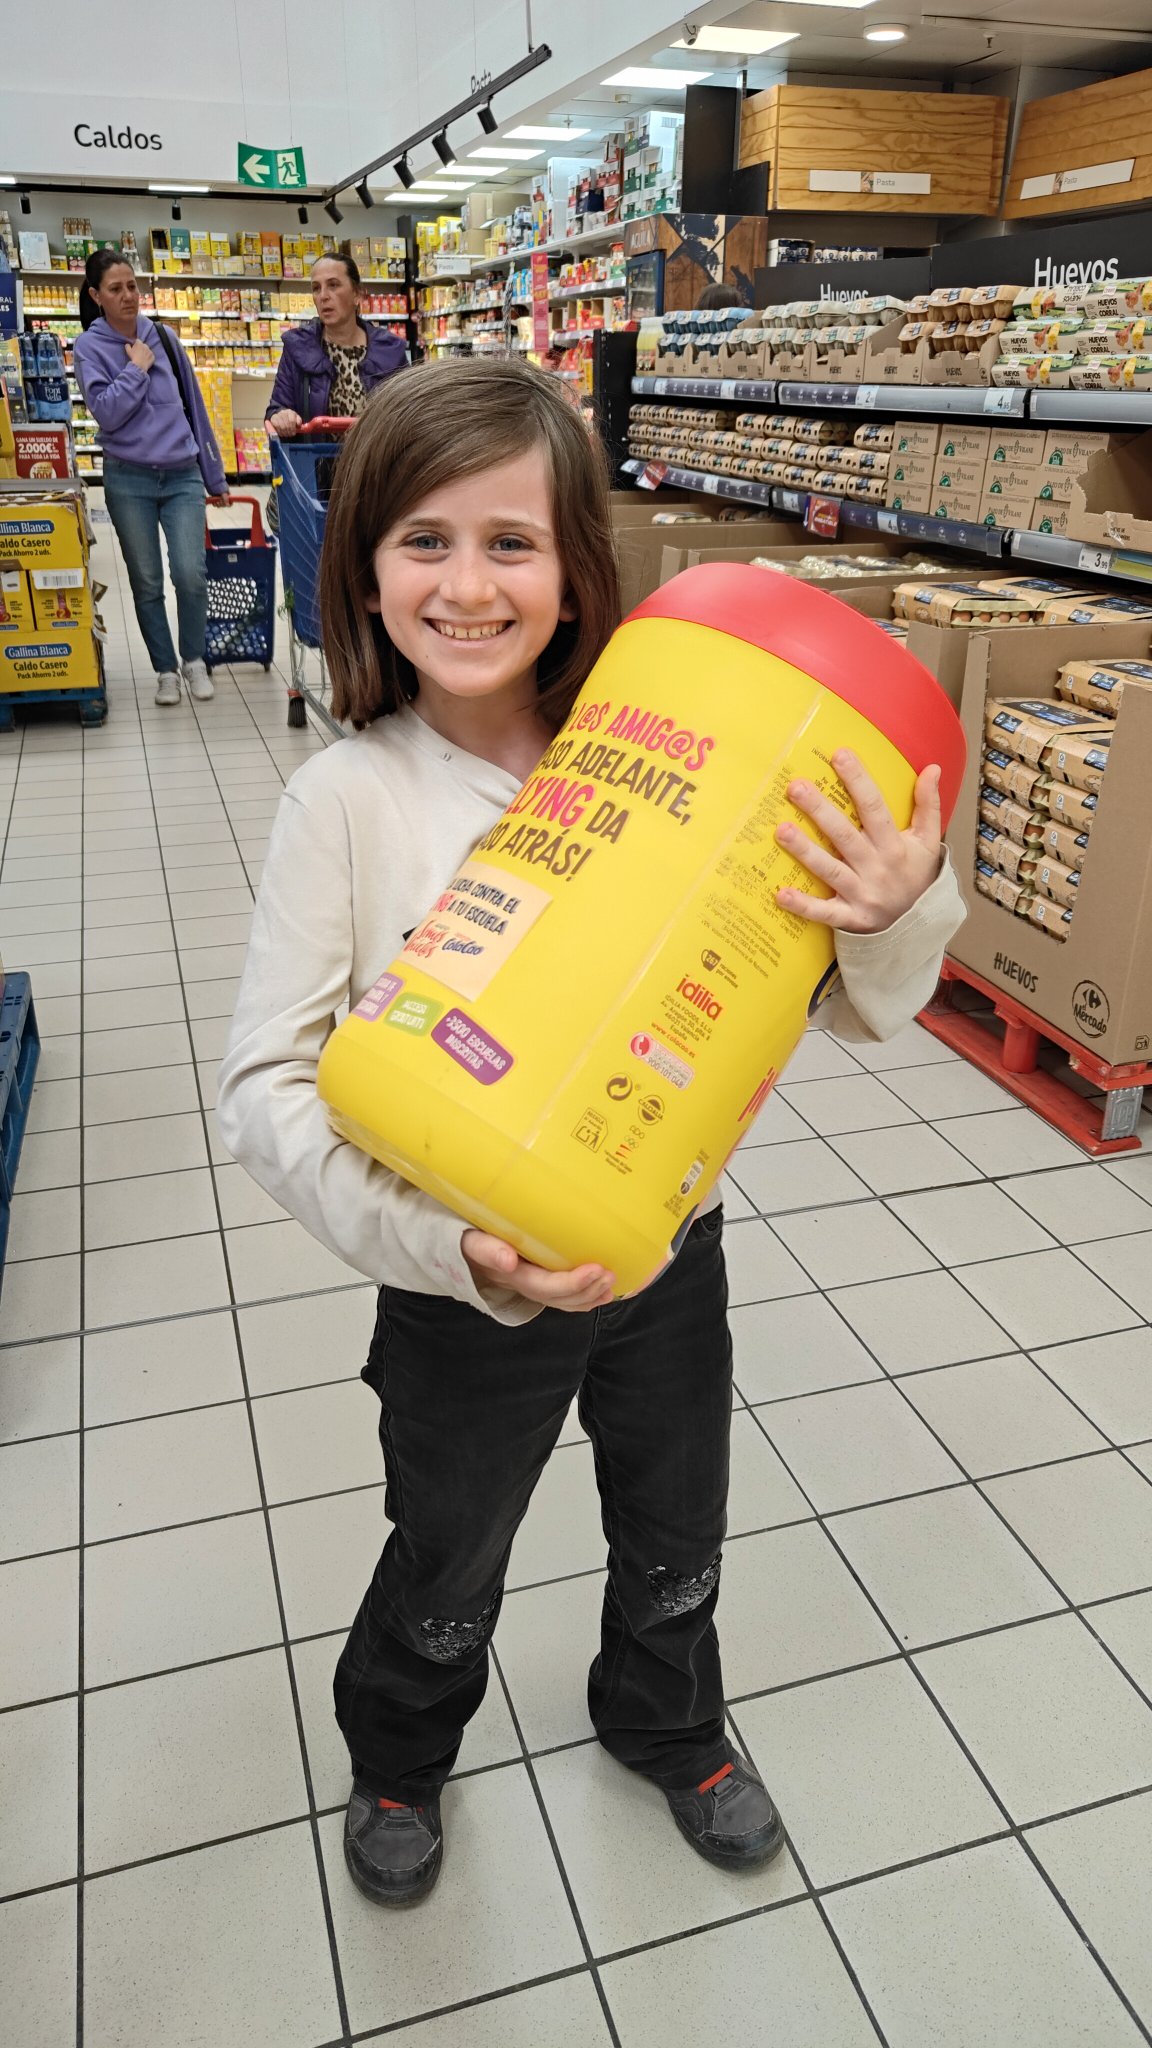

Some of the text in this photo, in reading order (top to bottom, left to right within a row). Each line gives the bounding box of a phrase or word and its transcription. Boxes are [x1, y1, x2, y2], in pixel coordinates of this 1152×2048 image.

[74, 124, 163, 150] Caldos
[876, 178, 896, 187] Pasta
[1063, 176, 1078, 185] Pasta
[1034, 256, 1119, 288] Huevos
[1097, 298, 1117, 306] HUEVOS
[1099, 309, 1119, 317] CORRAL
[18, 442, 53, 453] 2.000€
[21, 522, 51, 533] Blanca
[14, 549, 34, 557] Ahorro
[21, 538, 51, 548] Casero
[8, 645, 69, 658] Gallina Blanca
[13, 660, 68, 671] Caldo Casero
[568, 701, 610, 733] L@S
[604, 705, 715, 772] AMIG@S
[565, 741, 697, 826] ADELANTE,
[585, 800, 630, 845] DA
[498, 824, 593, 883] ATRÁS!
[471, 883, 508, 907] CONTRA
[503, 897, 521, 914] EL
[447, 900, 509, 936] A TU ESCUELA
[442, 938, 484, 956] ColaCao
[716, 969, 724, 977] por
[994, 951, 1039, 993] HUEVOS
[676, 973, 723, 1021] idilia
[665, 994, 681, 1009] IDILIA
[681, 1006, 700, 1024] FOODS,
[669, 1006, 688, 1022] Aragón
[1073, 1003, 1107, 1034] Mercado
[670, 1024, 688, 1041] España
[680, 1024, 700, 1042] Valencia
[444, 1034, 484, 1070] INSCRITAS
[466, 1034, 507, 1071] ESCUELAS
[647, 1056, 660, 1071] 900
[659, 1066, 672, 1080] 101
[670, 1074, 684, 1089] 048
